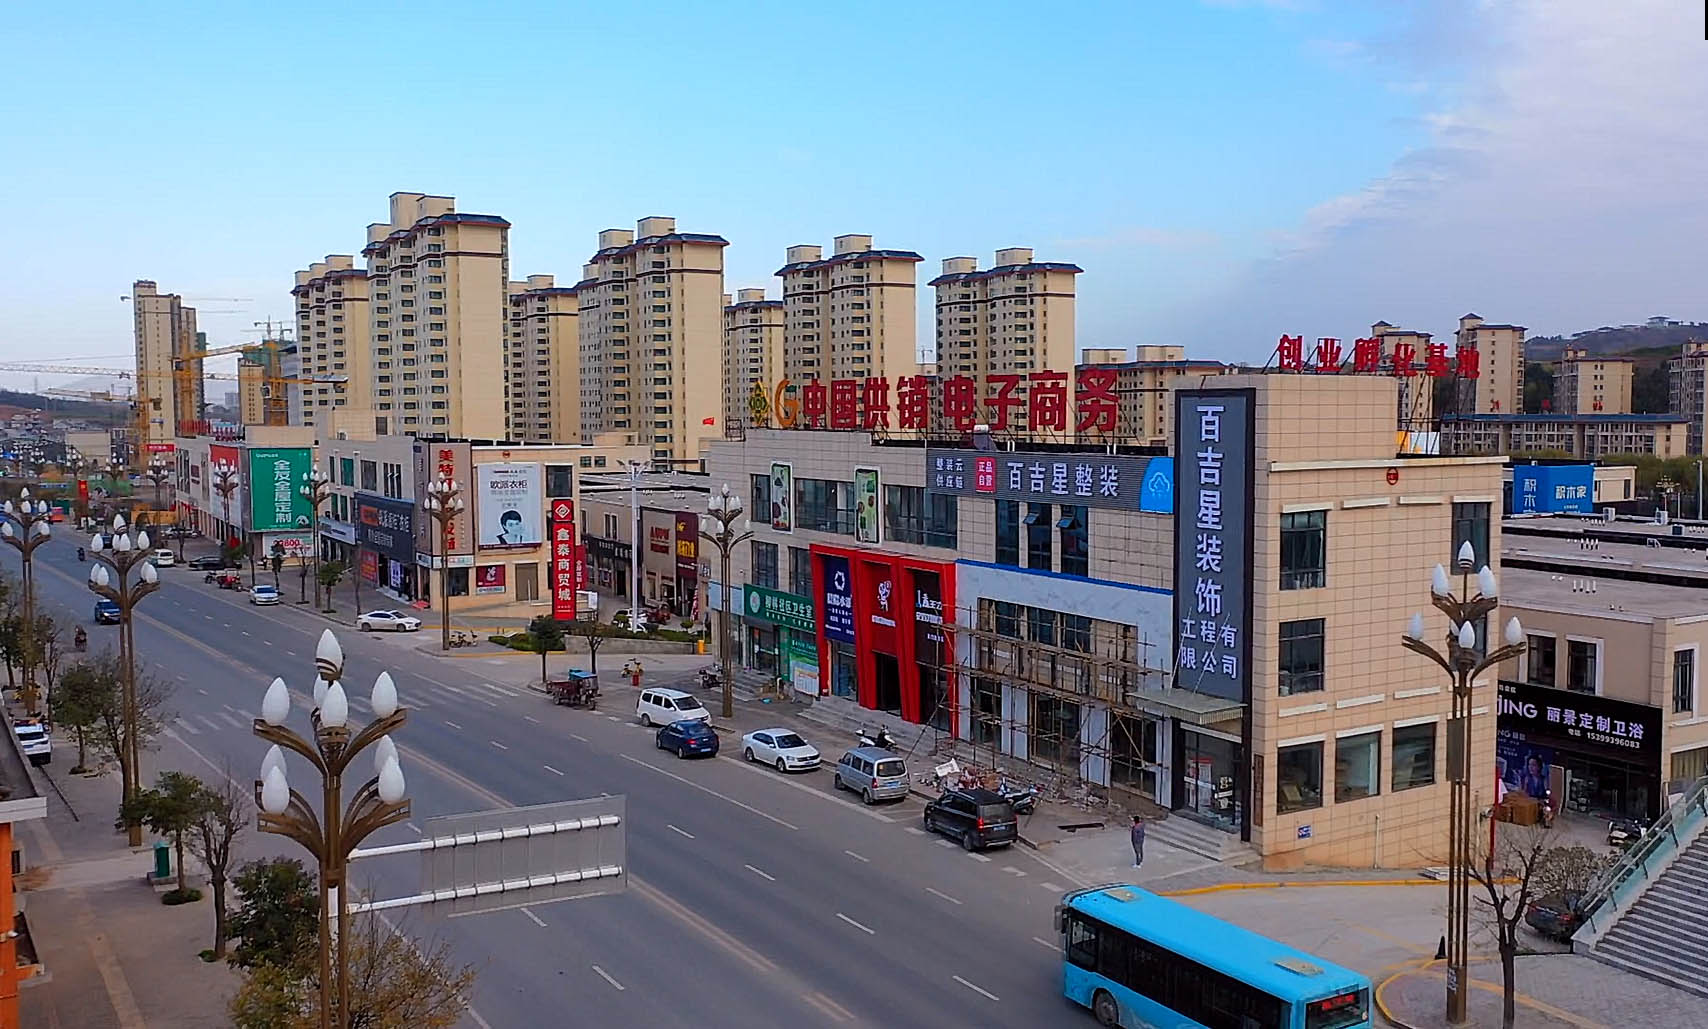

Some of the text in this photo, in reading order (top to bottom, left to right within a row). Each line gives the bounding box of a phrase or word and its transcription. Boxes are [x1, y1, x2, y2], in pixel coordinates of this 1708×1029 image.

[802, 369, 1119, 432] 中国供销电子商务
[1007, 461, 1119, 497] 百吉星整装
[1555, 485, 1587, 500] 积木家
[1195, 405, 1225, 617] 百吉星装饰
[556, 527, 572, 601] 鑫泰商贸城
[1546, 705, 1645, 740] 丽景定制卫浴
